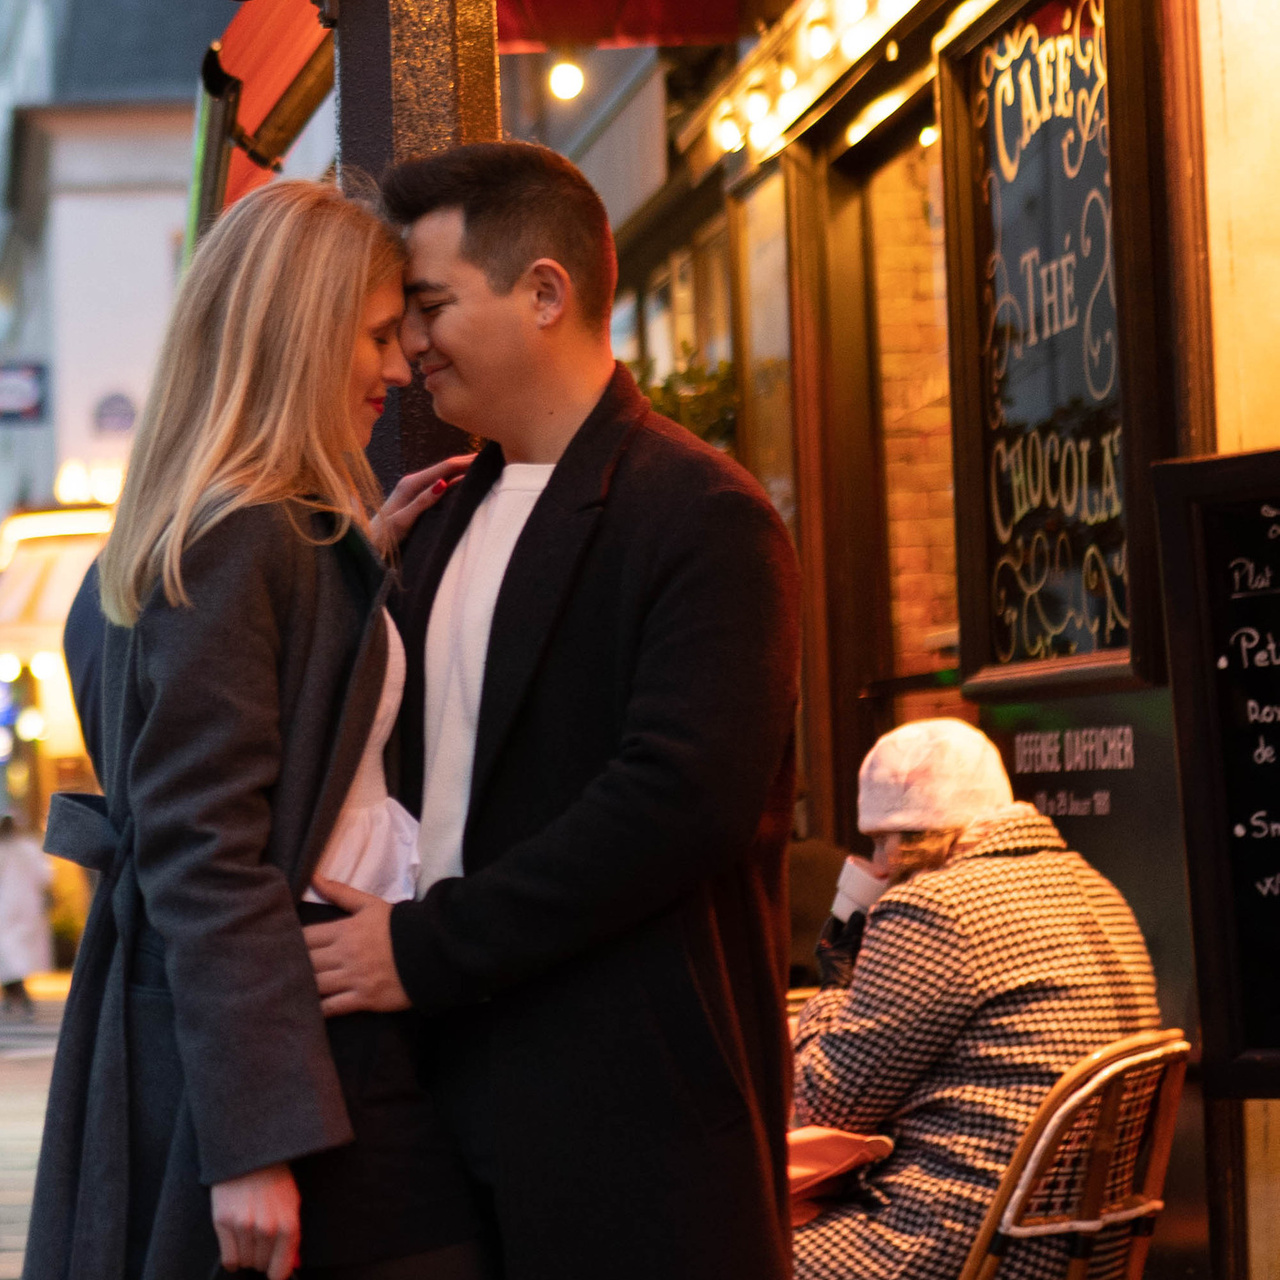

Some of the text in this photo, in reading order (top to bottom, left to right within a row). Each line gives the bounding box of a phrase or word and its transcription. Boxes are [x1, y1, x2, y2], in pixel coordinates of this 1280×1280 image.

[995, 8, 1074, 183] CAFÉ
[1020, 233, 1079, 348] THÉ
[1253, 734, 1276, 765] de
